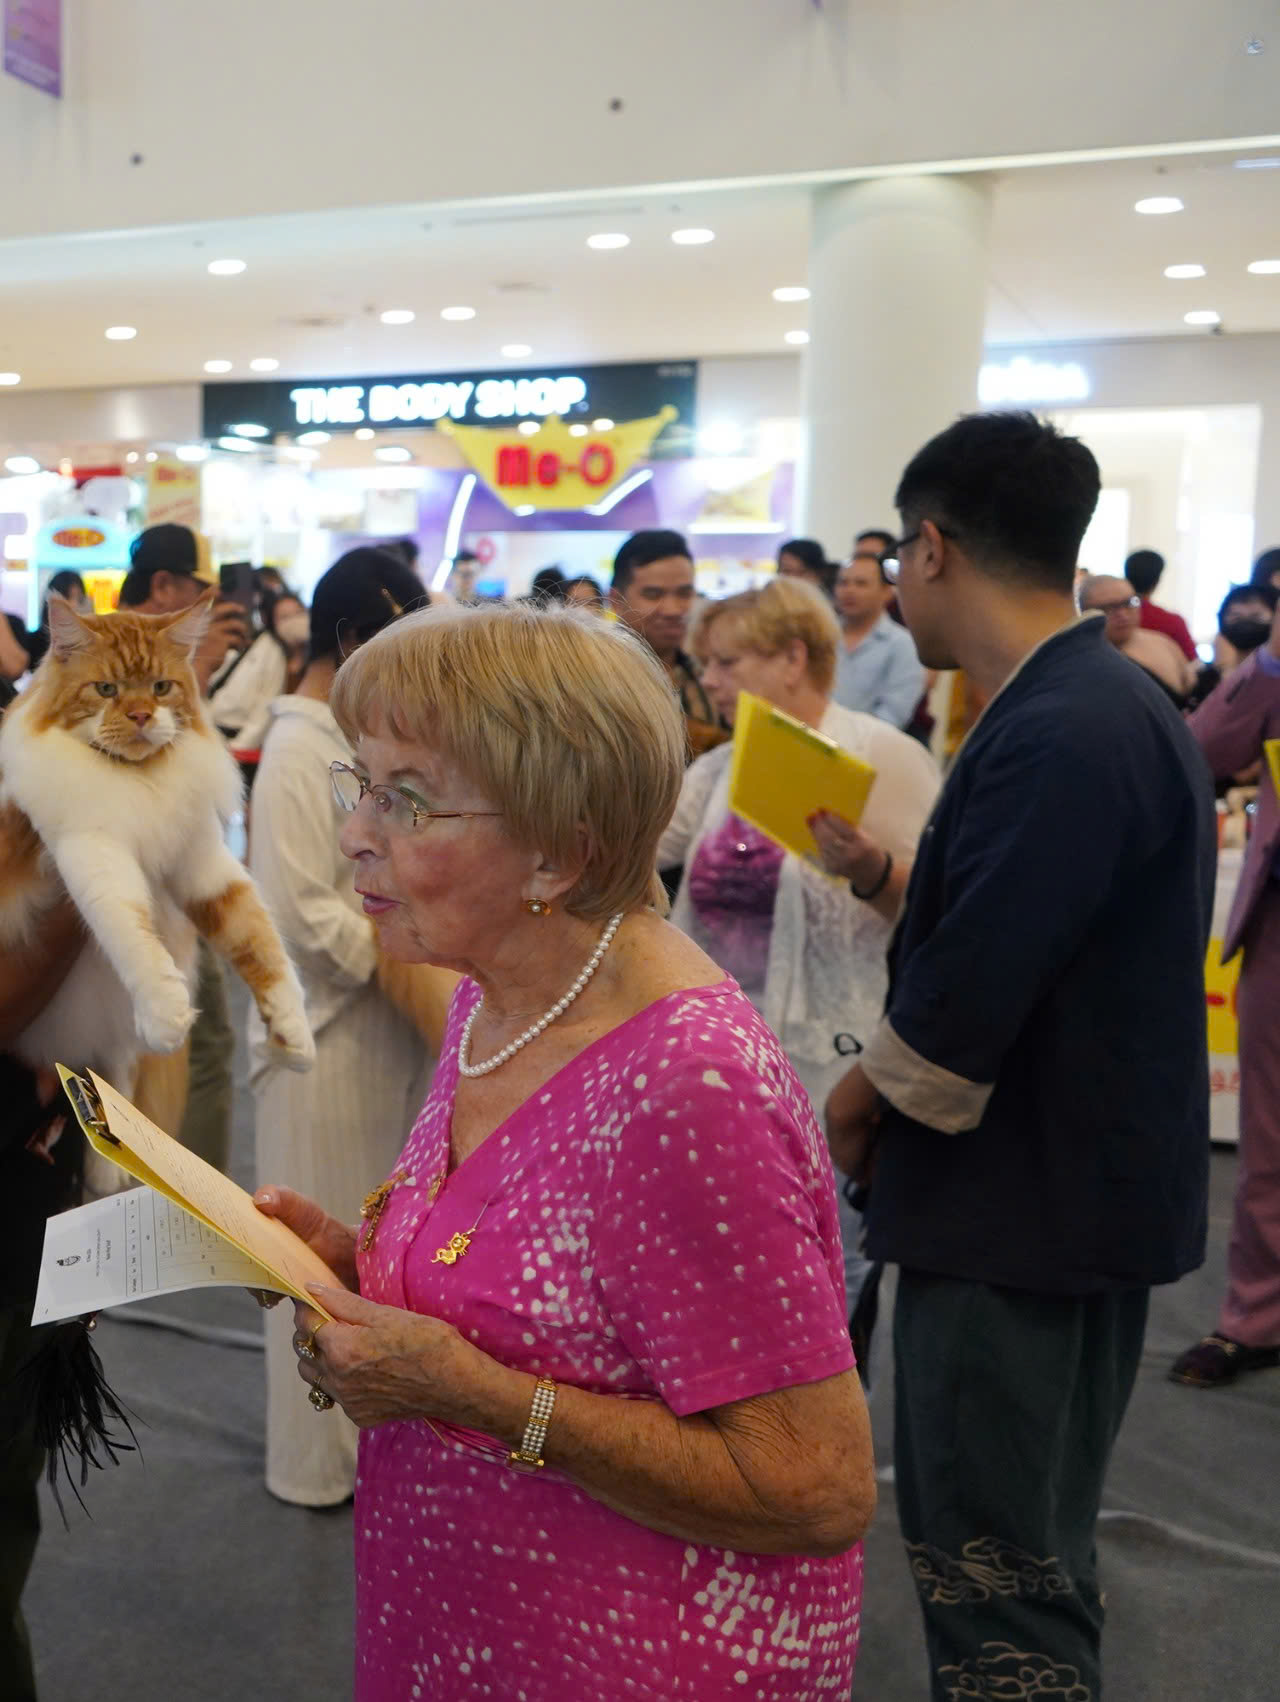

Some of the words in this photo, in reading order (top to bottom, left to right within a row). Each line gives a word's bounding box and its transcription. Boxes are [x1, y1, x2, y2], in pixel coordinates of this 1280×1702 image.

[290, 386, 364, 424] THE
[369, 381, 474, 421] BODY
[475, 376, 587, 418] SHOP
[495, 443, 615, 488] Me-O
